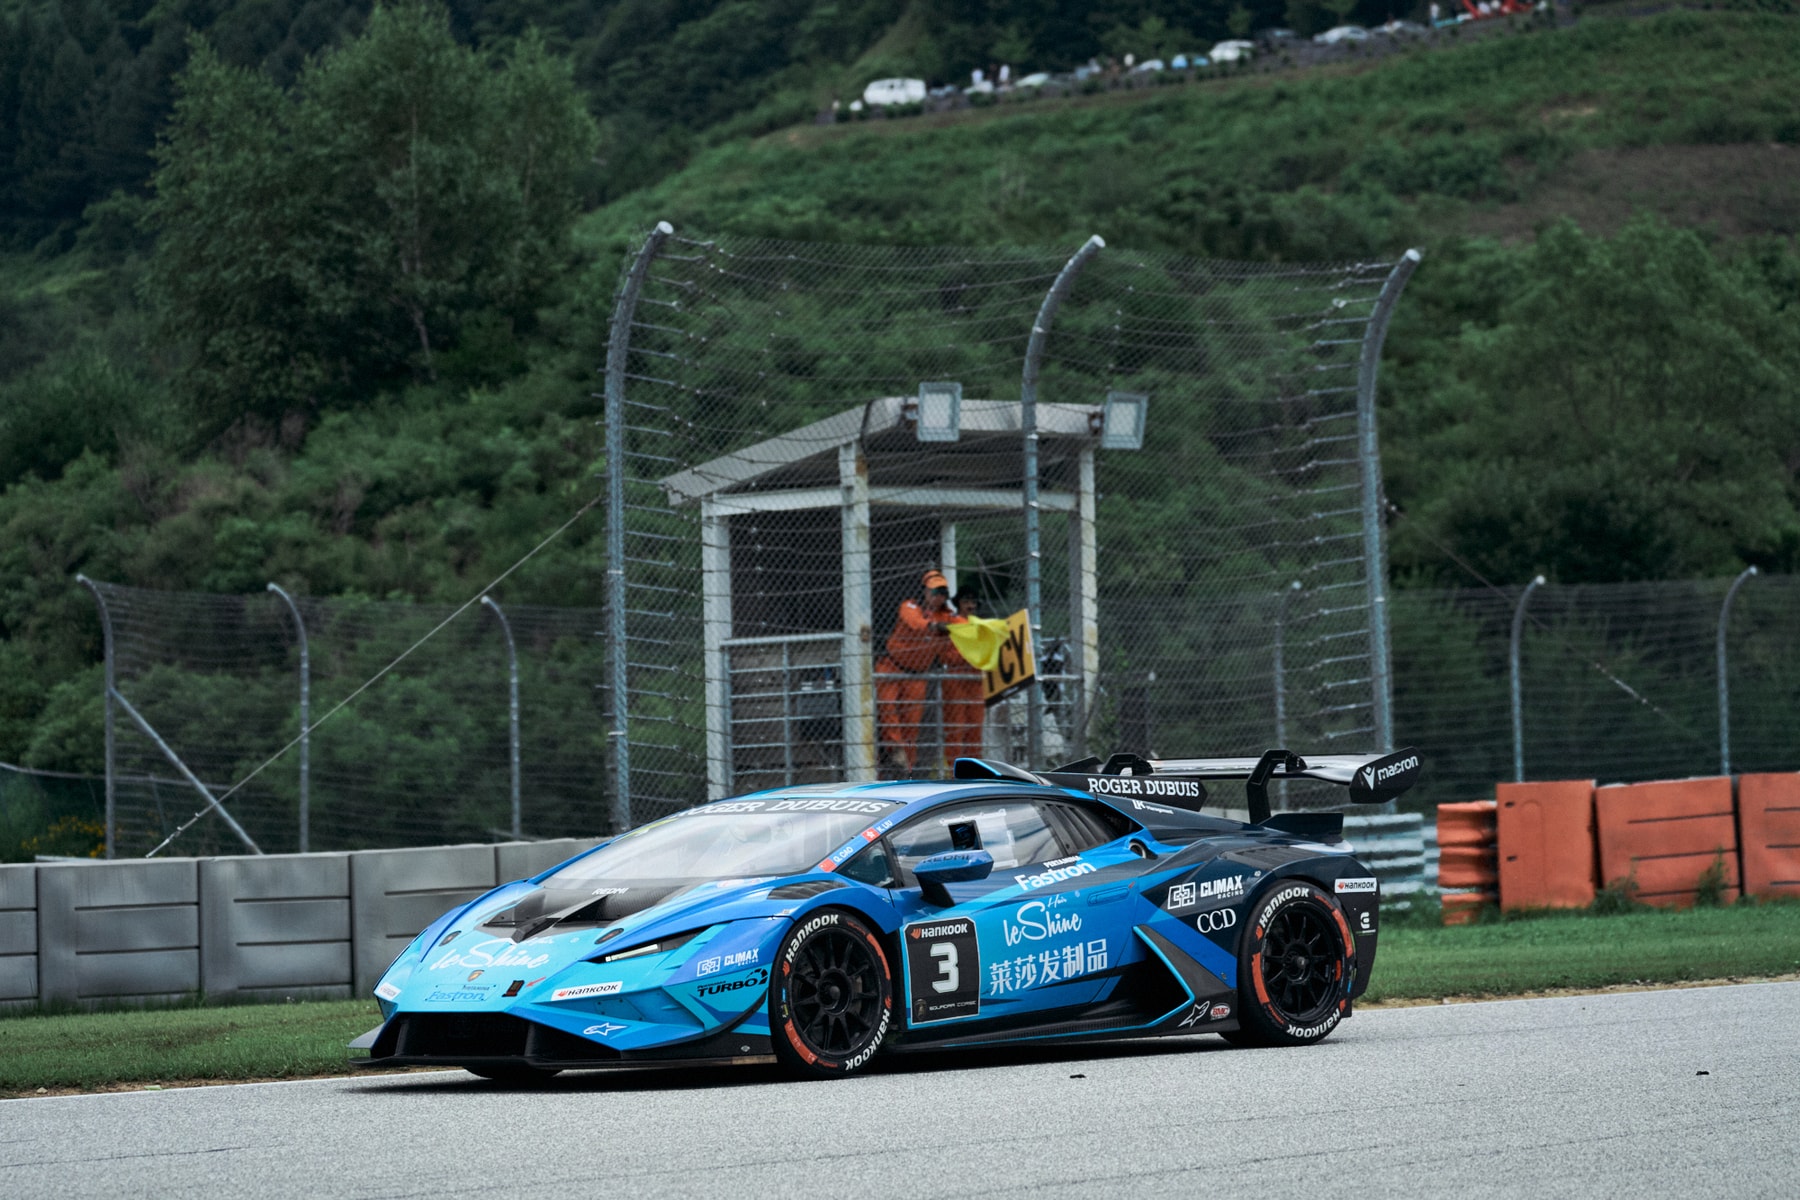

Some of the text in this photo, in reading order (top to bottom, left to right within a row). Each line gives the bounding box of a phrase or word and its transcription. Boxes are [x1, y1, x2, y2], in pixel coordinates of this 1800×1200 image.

[986, 624, 1026, 693] CY
[1377, 755, 1419, 781] macron
[1087, 777, 1200, 798] ROGER DUBUIS
[765, 800, 890, 814] DUBUIS
[1014, 861, 1097, 891] Fastron
[1200, 875, 1243, 898] CLIMAX
[590, 887, 630, 896] REDMI
[1217, 890, 1244, 900] RACING
[1196, 908, 1237, 934] CCD
[724, 948, 760, 966] CLIMAX
[930, 942, 960, 994] 3
[988, 938, 1108, 996] 莱莎发制品
[429, 991, 485, 1001] Fastron
[697, 978, 758, 998] TURBO
